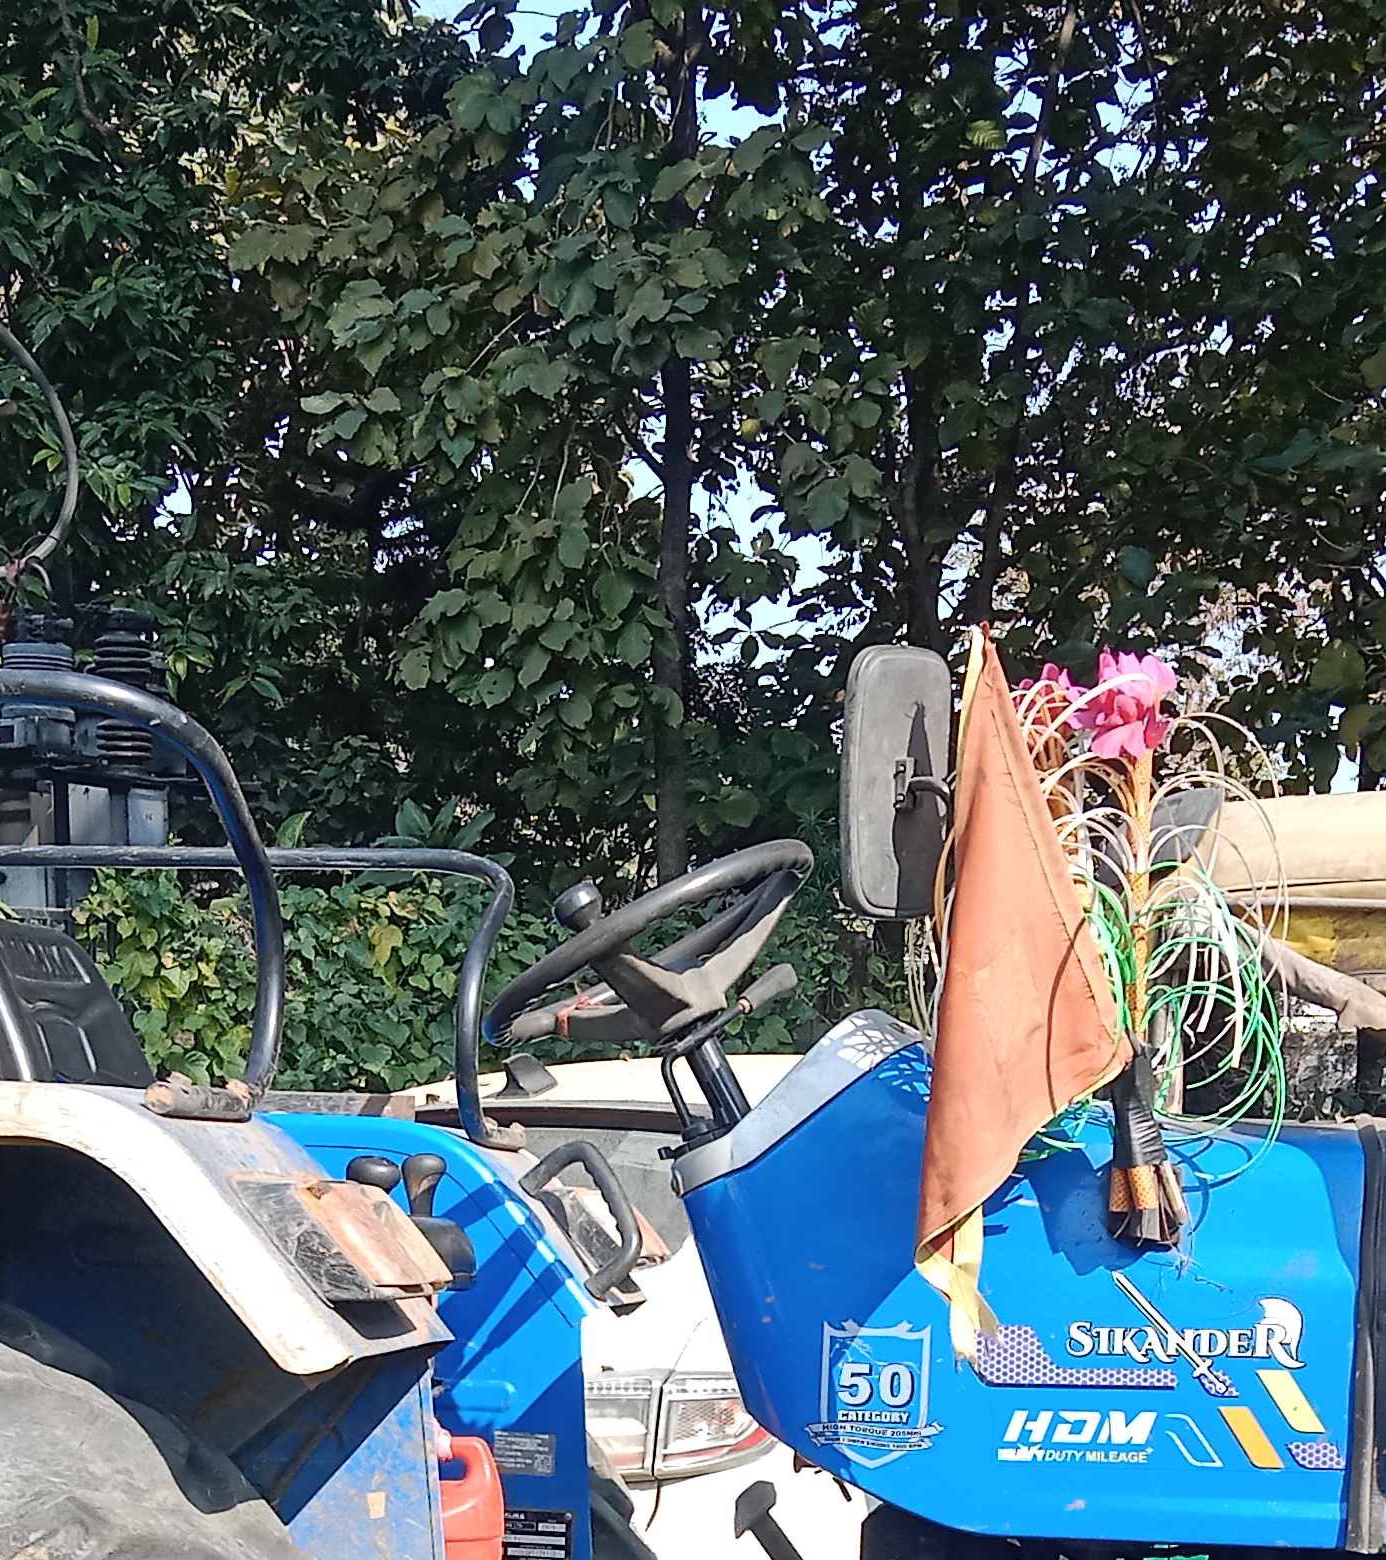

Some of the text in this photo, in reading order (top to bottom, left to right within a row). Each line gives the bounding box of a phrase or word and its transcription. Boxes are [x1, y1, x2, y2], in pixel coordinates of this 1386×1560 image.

[1066, 1318, 1307, 1369] SIKANDER
[837, 1362, 915, 1408] 50
[838, 1410, 911, 1425] CATEGORY
[849, 1424, 888, 1436] TORQUE
[1002, 1410, 1158, 1445] HDM
[1044, 1449, 1087, 1462] DUTY
